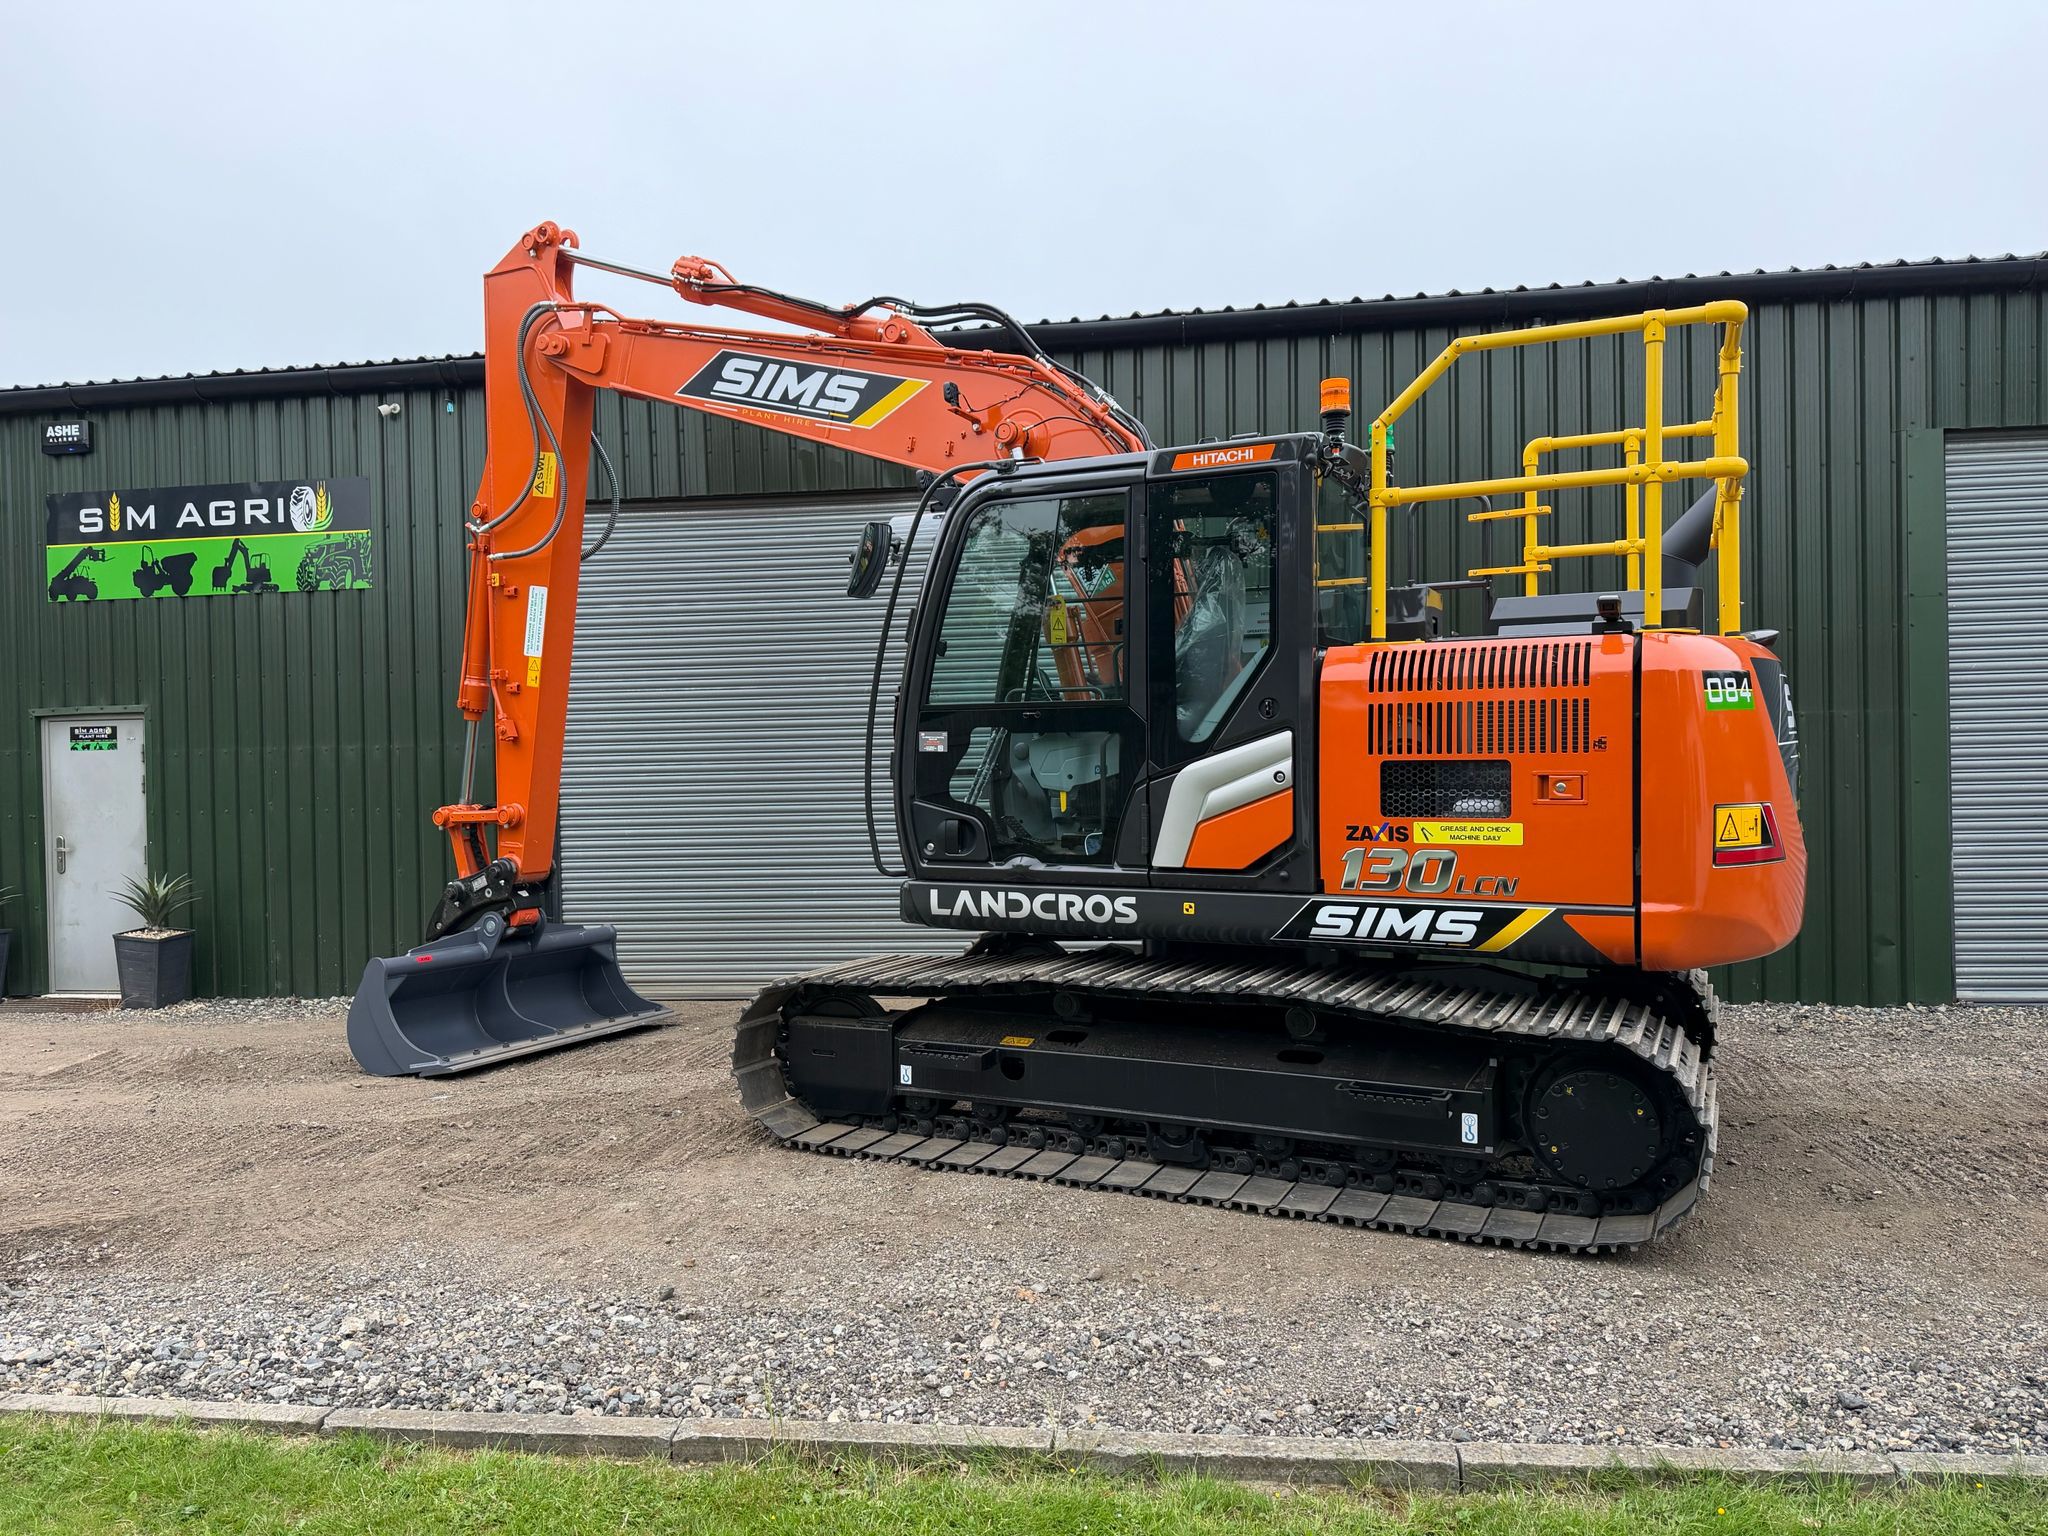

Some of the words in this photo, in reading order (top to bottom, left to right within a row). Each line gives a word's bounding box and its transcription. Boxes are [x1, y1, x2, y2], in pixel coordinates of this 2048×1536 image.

[713, 358, 869, 412] SIMS
[742, 409, 780, 421] PLANT
[783, 415, 811, 427] HIRE
[46, 424, 80, 437] ASHE
[1193, 449, 1254, 465] HITACHI
[1706, 678, 1752, 702] 084
[1346, 822, 1409, 843] ZAXIS
[1340, 847, 1458, 894] 130
[1454, 875, 1520, 896] LCN
[930, 889, 1138, 924] LANDCROS
[1310, 906, 1484, 943] SIMS
